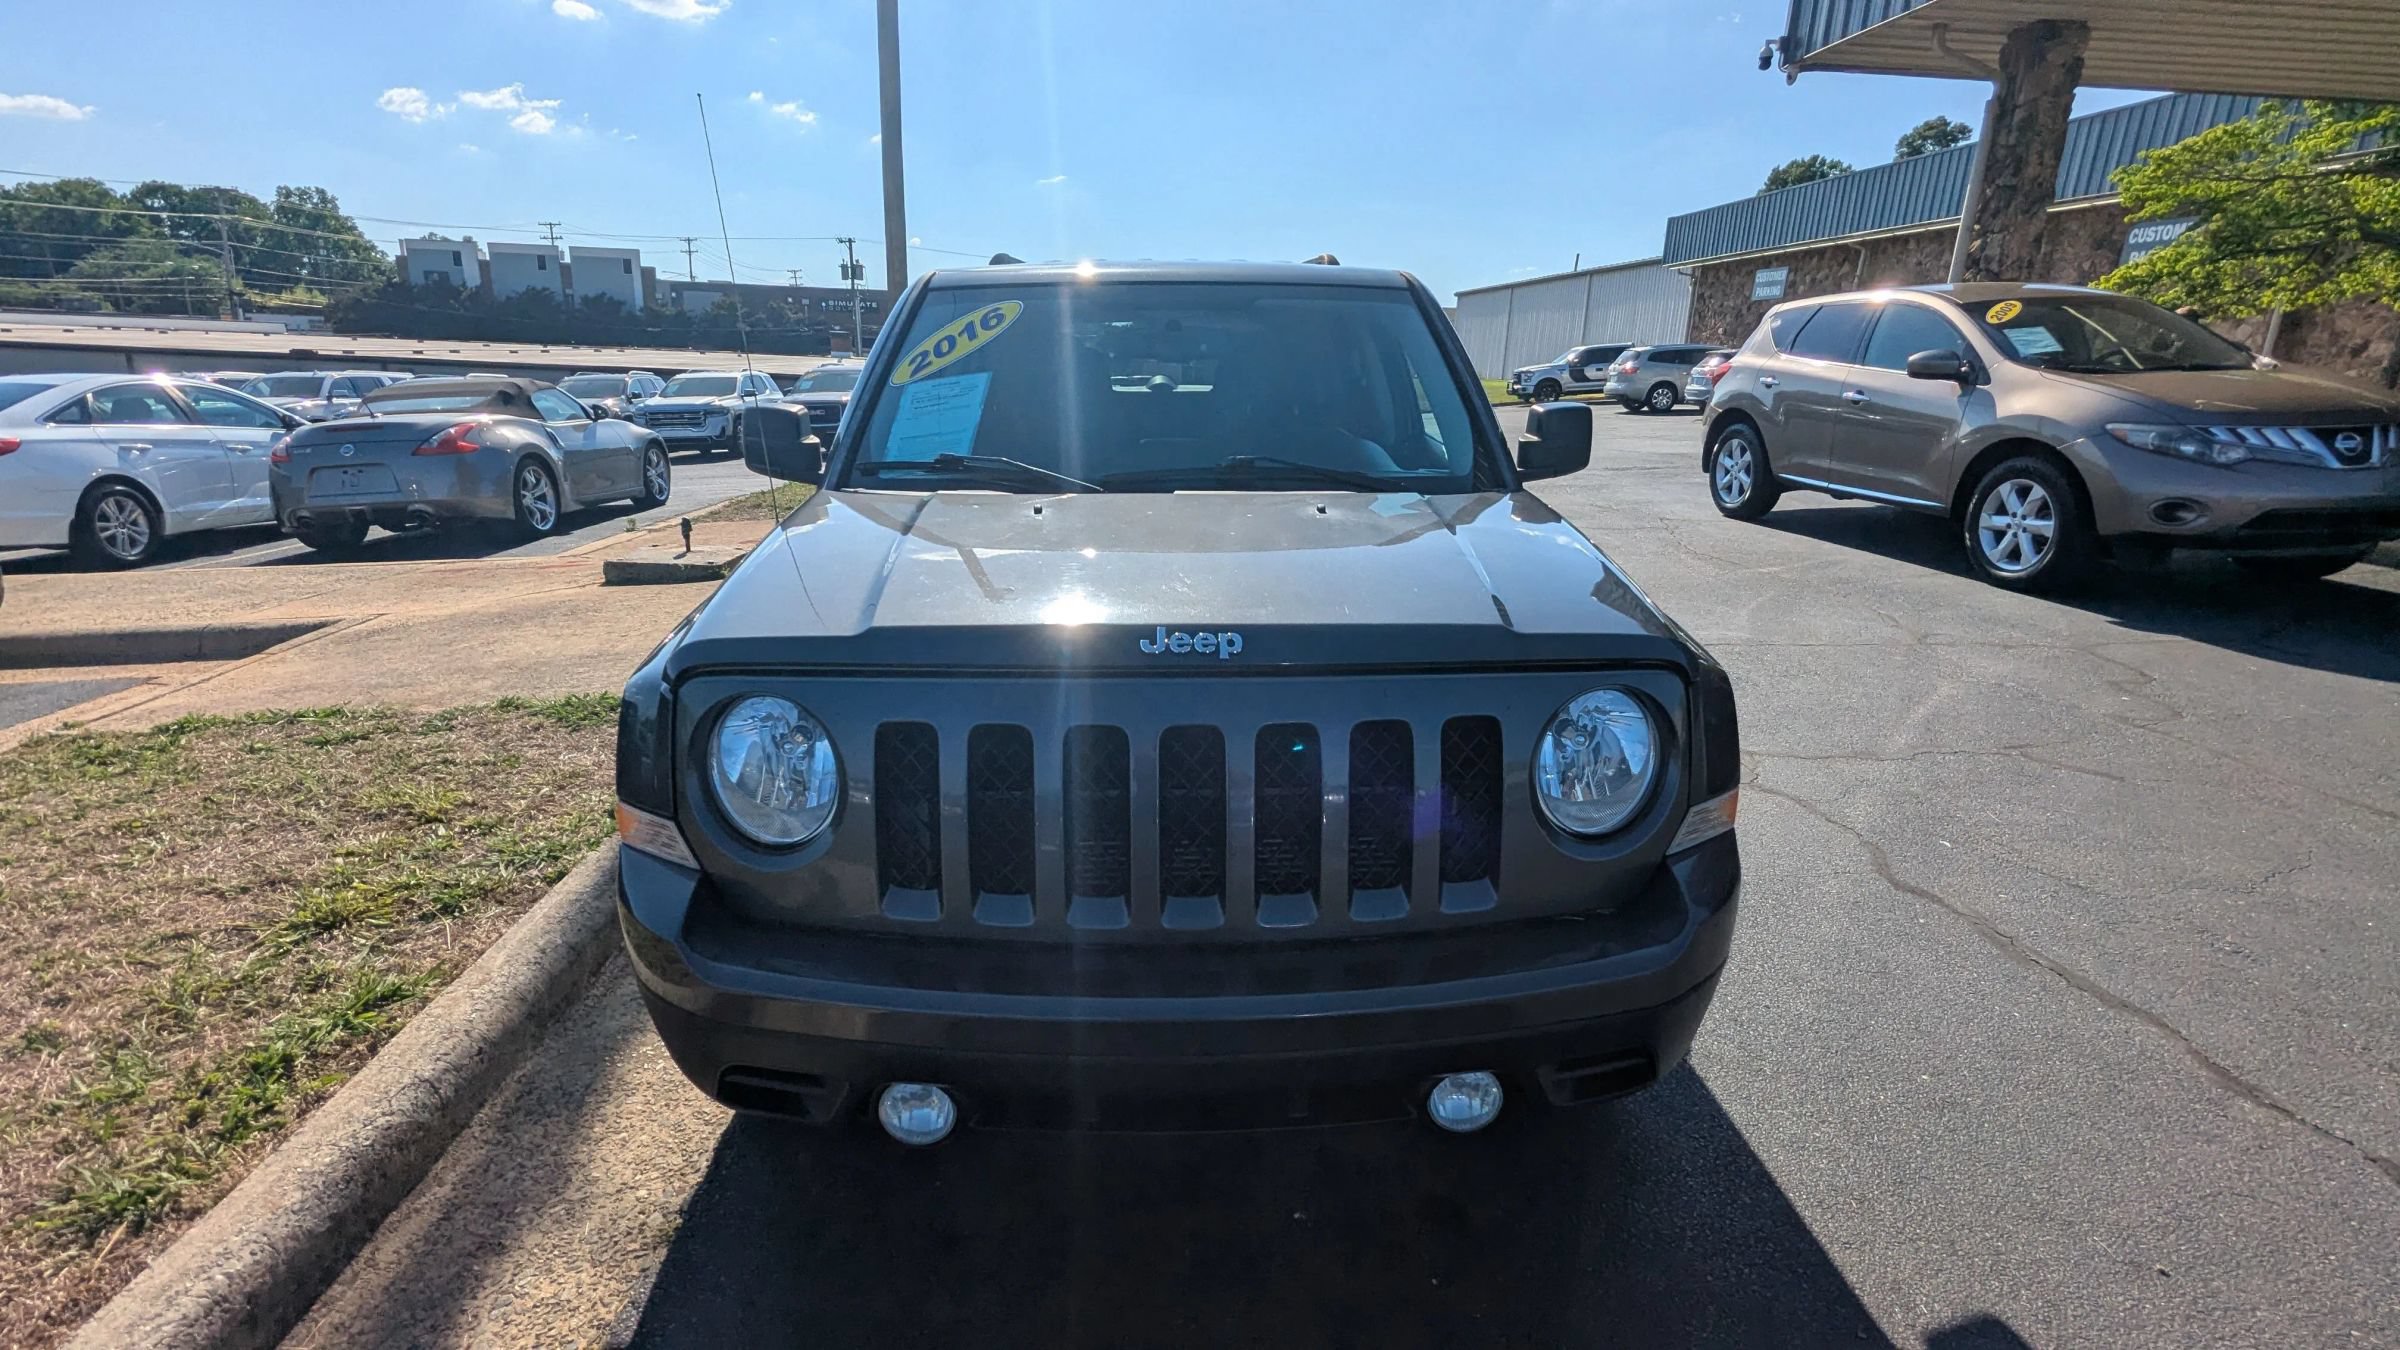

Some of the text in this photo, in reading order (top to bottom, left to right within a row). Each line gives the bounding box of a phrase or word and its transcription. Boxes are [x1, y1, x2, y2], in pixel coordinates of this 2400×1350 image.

[2128, 222, 2194, 244] CUSTOM
[828, 300, 878, 308] SIMUATE
[1990, 302, 2018, 322] 2009
[907, 306, 1007, 378] 2016
[1139, 626, 1243, 660] Jeep
